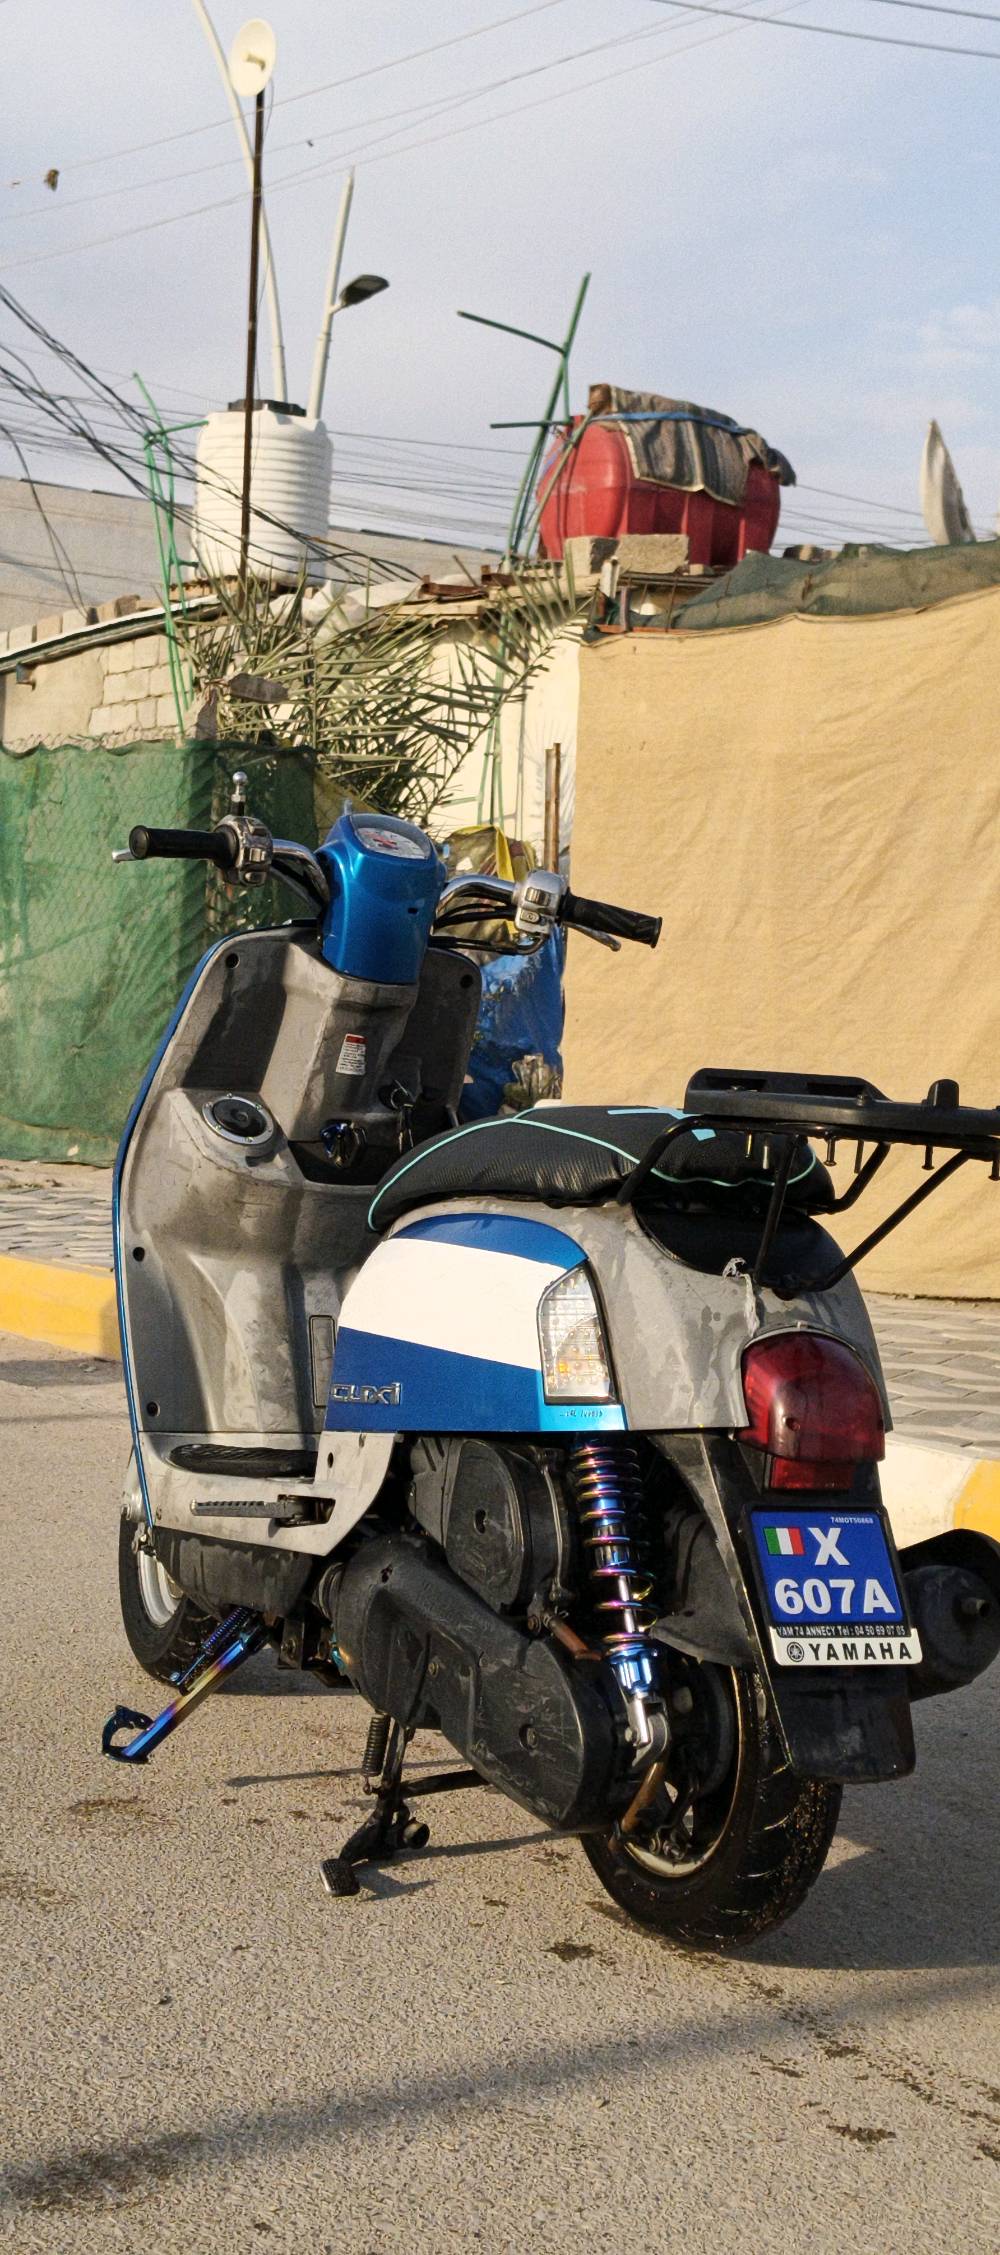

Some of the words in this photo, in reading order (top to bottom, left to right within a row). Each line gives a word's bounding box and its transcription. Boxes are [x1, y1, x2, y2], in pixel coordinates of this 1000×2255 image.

[807, 1527, 850, 1566] X
[774, 1578, 896, 1615] 607A
[776, 1626, 794, 1637] YAM
[794, 1626, 805, 1637] 74
[805, 1625, 836, 1637] ANNECY
[854, 1625, 865, 1637] 04
[865, 1625, 875, 1637] 50
[885, 1625, 895, 1637] 07
[809, 1642, 912, 1661] YAMAHA
